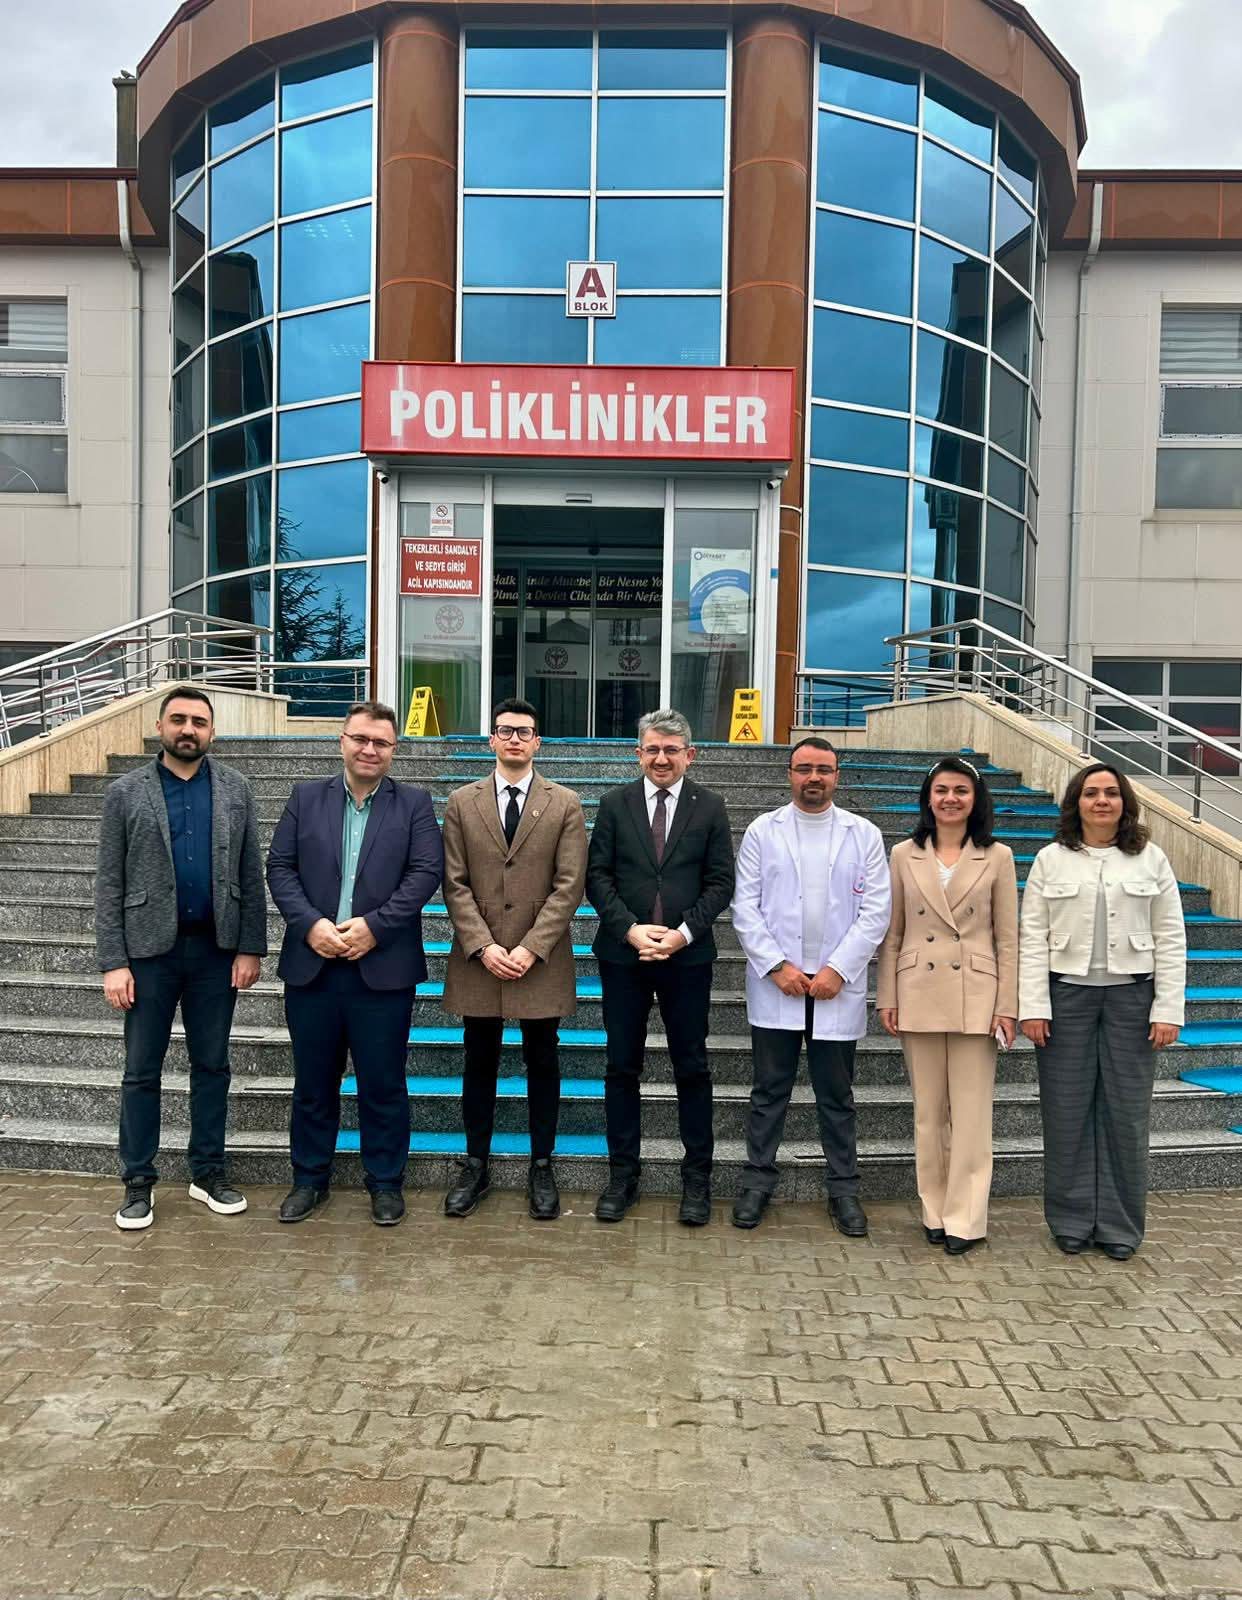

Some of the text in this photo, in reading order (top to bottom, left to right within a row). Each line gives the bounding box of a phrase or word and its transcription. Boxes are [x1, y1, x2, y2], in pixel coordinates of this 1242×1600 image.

[576, 268, 607, 298] A
[574, 302, 608, 311] BLOK
[390, 380, 767, 444] POLİKLİNİKLER
[404, 543, 478, 556] TEKERLEKLİ SANDALYE
[415, 560, 467, 575] VE SEDYE GİRİŞİ
[407, 576, 473, 590] ACİL KAPISINDANDIR
[617, 575, 648, 587] Nesne
[651, 576, 664, 587] Yo
[493, 590, 531, 600] Olmaa
